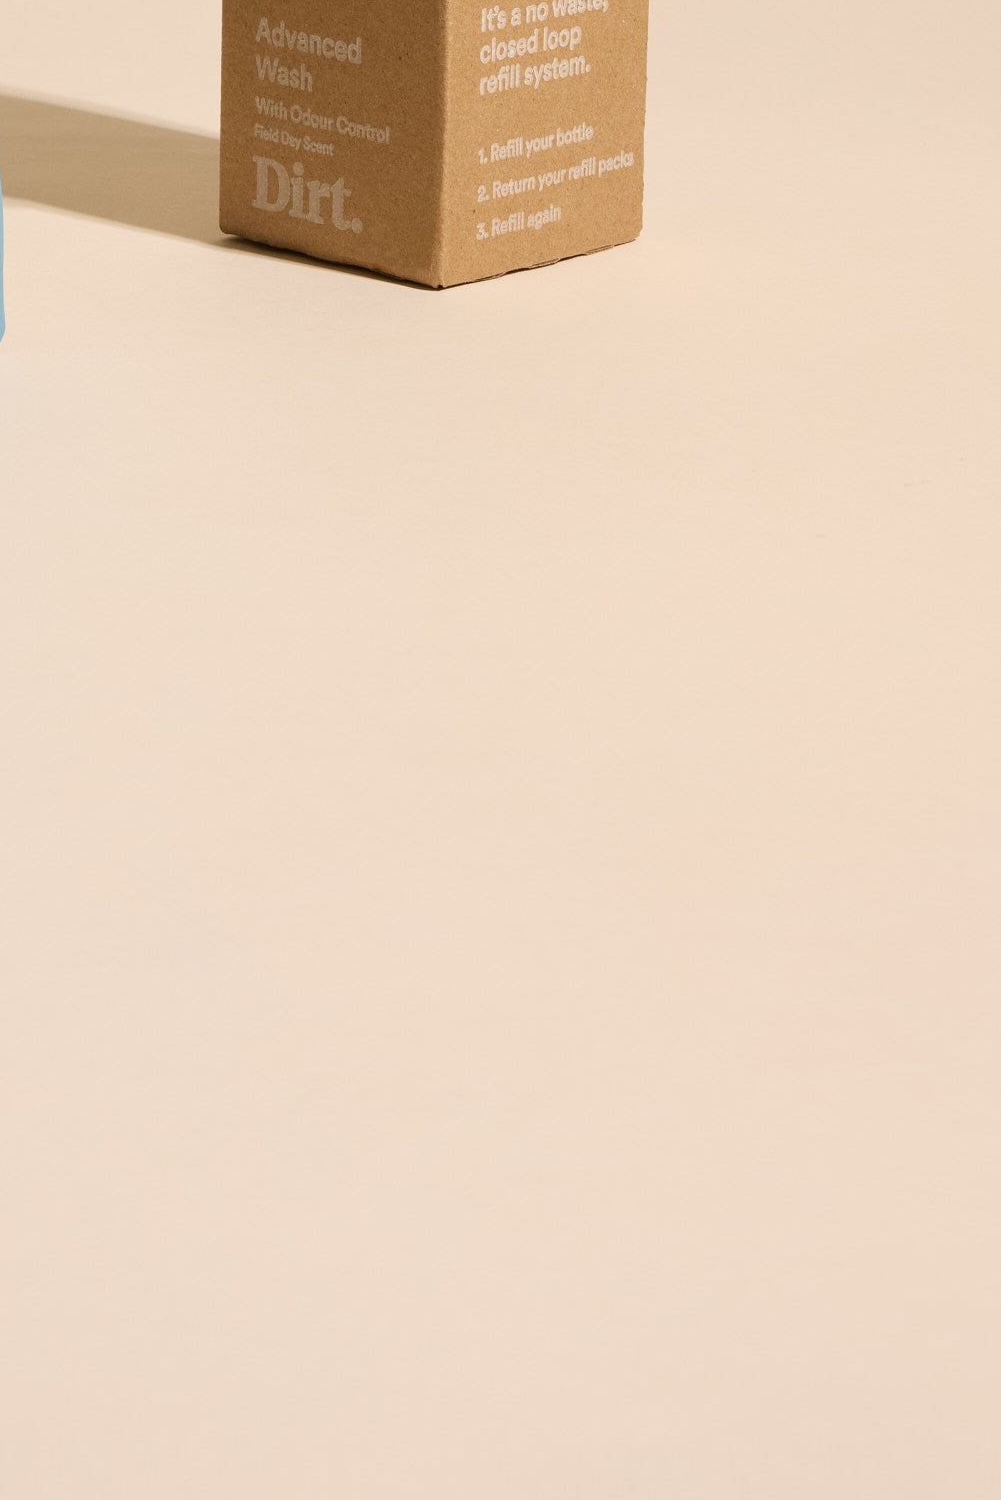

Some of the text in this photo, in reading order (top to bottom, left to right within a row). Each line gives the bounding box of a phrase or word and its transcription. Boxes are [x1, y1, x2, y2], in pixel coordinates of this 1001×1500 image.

[481, 5, 506, 32] It's
[511, 7, 521, 27] a
[526, 2, 548, 23] no
[255, 17, 362, 64] Advanced
[480, 25, 582, 64] closed loop
[255, 54, 312, 92] Wash
[479, 54, 591, 96] refill system.
[254, 123, 334, 156] Field Day Scent
[255, 96, 390, 145] With Odour Control
[478, 122, 594, 165] 1. Refill your bottle
[252, 155, 363, 234] Dirt.
[477, 150, 634, 203] 2. Return your refill packs
[476, 204, 561, 240] 3. Refill again
